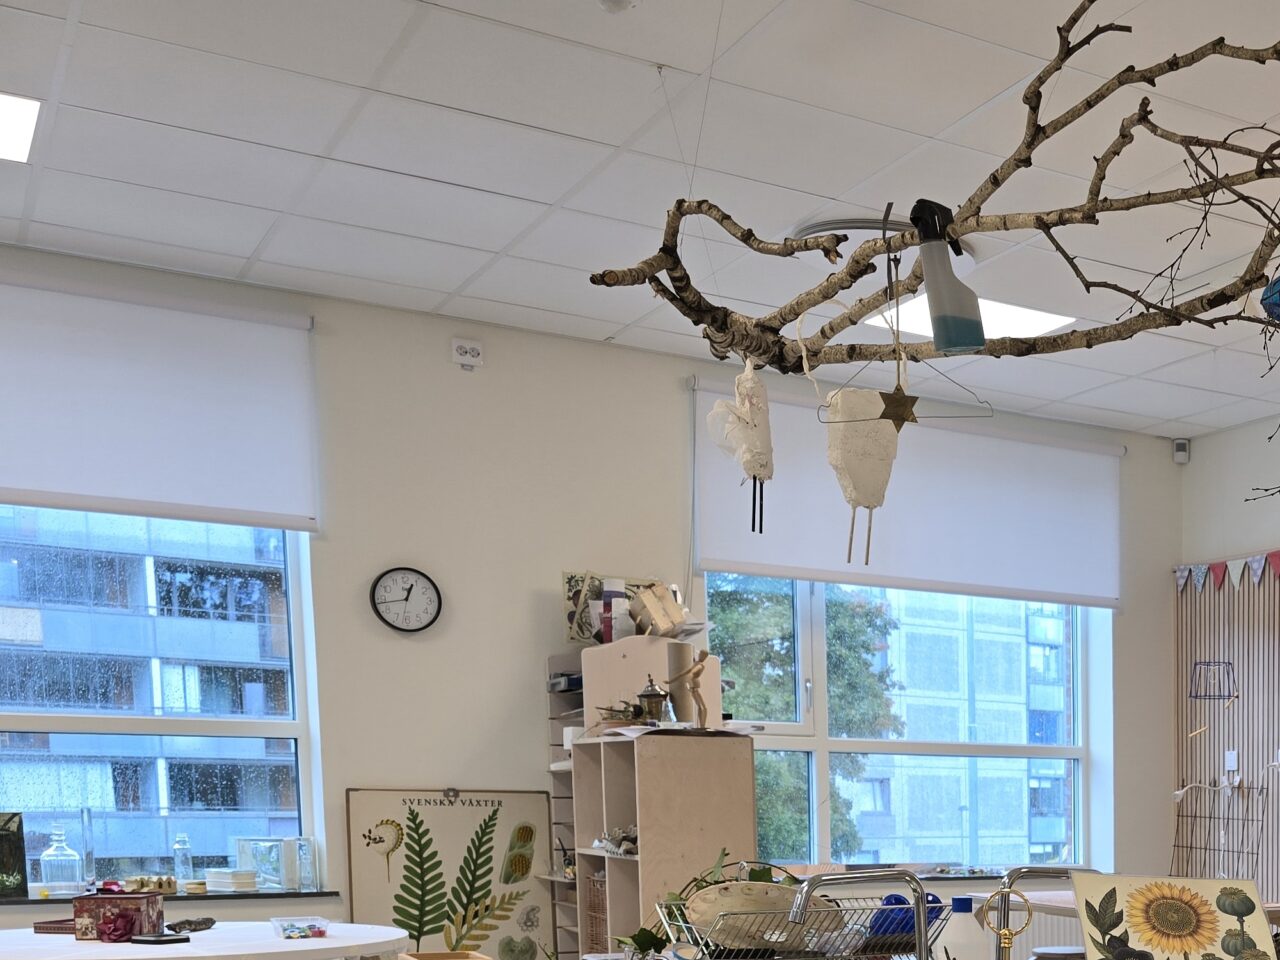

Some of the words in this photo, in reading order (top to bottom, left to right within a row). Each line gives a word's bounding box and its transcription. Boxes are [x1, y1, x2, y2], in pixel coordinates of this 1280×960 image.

[392, 577, 398, 586] 11
[401, 575, 409, 584] 12
[383, 585, 391, 593] 10
[421, 586, 428, 595] 2
[426, 596, 432, 606] 3
[385, 605, 391, 614] 8
[394, 612, 399, 621] 7
[405, 615, 411, 624] 6
[416, 613, 421, 622] 5
[401, 798, 455, 806] SVENSKA
[460, 798, 503, 808] VÄXTER
